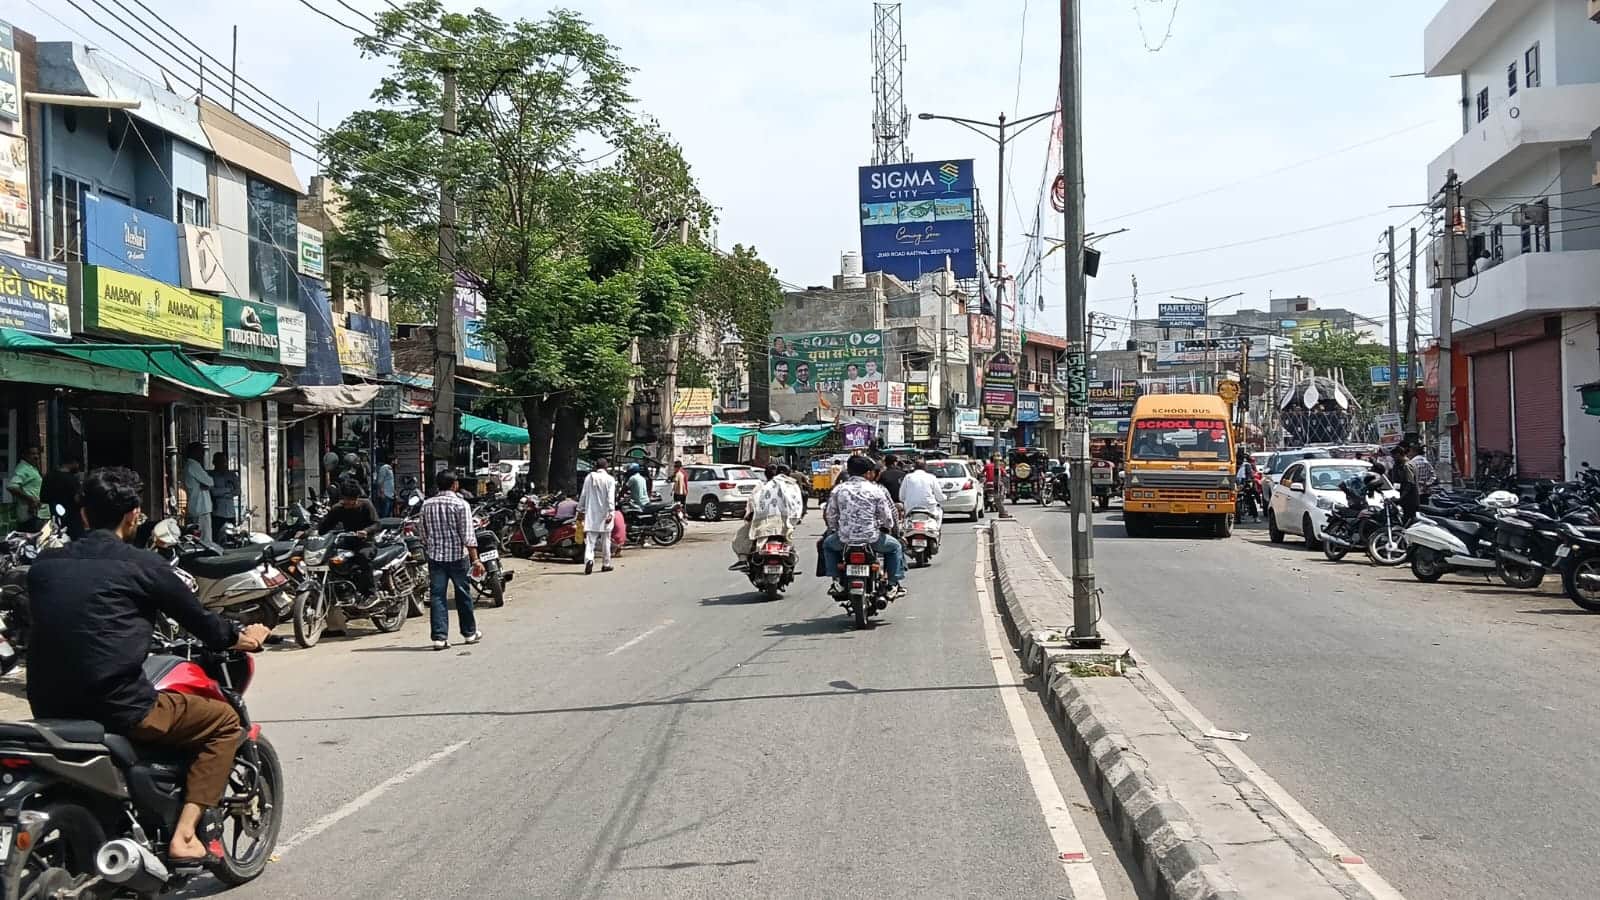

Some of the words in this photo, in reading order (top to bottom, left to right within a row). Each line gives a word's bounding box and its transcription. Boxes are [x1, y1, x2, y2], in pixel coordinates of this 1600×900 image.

[871, 169, 935, 189] SIGMA
[889, 189, 918, 199] CITY
[895, 226, 922, 245] Coming
[925, 226, 941, 240] Soon
[104, 284, 141, 307] AMARON
[167, 300, 199, 320] AMARON
[1160, 304, 1204, 312] HARTRON
[225, 328, 259, 346] TRIDENT
[863, 381, 878, 389] OM
[1136, 420, 1191, 429] SCHOOL
[1195, 420, 1224, 429] BUS
